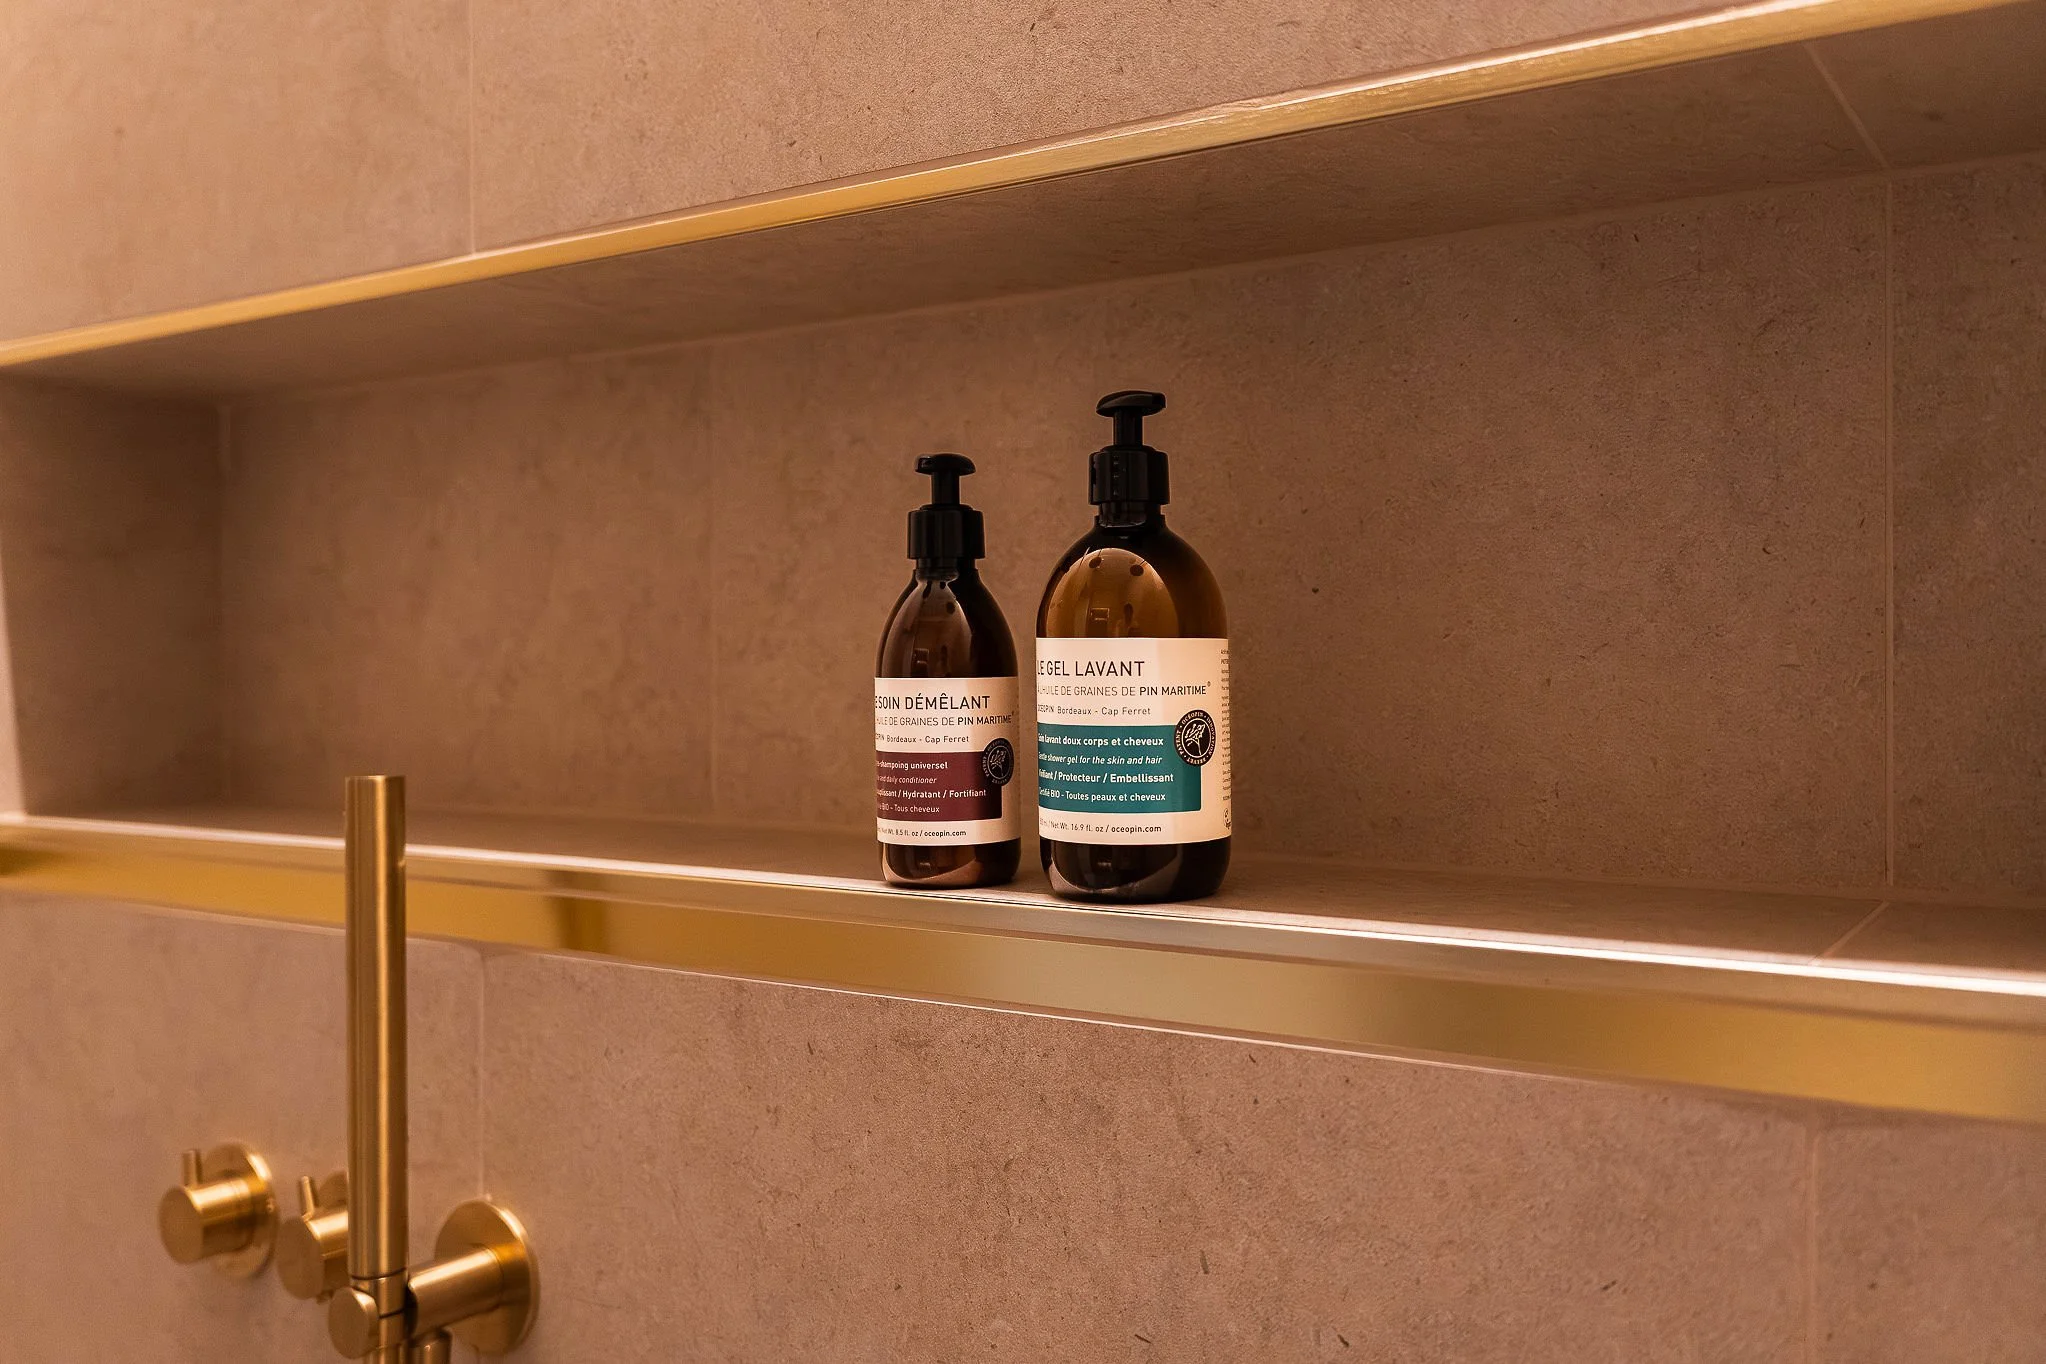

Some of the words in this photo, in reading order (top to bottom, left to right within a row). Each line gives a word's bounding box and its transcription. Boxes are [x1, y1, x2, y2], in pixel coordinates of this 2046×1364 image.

[1046, 660, 1070, 676] GEL
[1075, 660, 1145, 677] LAVANT
[1060, 685, 1072, 696] DE
[1074, 686, 1118, 697] GRAINES
[1121, 686, 1136, 697] DE
[1139, 686, 1158, 696] PIN
[878, 696, 900, 710] SOIN
[905, 692, 991, 710] DÉMÊLANT
[1057, 705, 1092, 715] Bordeaux
[1101, 706, 1119, 717] Cap
[1122, 706, 1151, 715] Ferret
[889, 716, 899, 726] DE
[900, 716, 939, 727] GRAINES
[941, 716, 955, 726] DE
[957, 716, 974, 726] PIN
[886, 734, 917, 743] Bordeaux
[925, 735, 940, 745] Cap
[943, 735, 970, 743] Ferret
[1045, 734, 1062, 745] lavant
[1062, 735, 1082, 746] doux
[1083, 738, 1109, 748] corps
[1111, 737, 1121, 746] et
[1123, 736, 1164, 746] cheveux
[910, 761, 948, 769] universel
[1066, 755, 1078, 766] gel
[1079, 755, 1091, 764] for
[1092, 756, 1105, 765] the
[1106, 755, 1125, 765] skin
[1127, 756, 1144, 765] and
[1145, 755, 1163, 764] hair
[898, 777, 938, 785] conditioner
[1058, 771, 1101, 783] Protecteur
[1102, 772, 1108, 784] /
[1110, 773, 1174, 783] Embellissant
[902, 790, 941, 799] Hydratant
[949, 789, 987, 798] Fortifiant
[1050, 789, 1061, 799] BIO
[1065, 790, 1090, 801] Toutes
[1091, 793, 1117, 803] peaux
[1118, 793, 1128, 801] et
[1129, 792, 1166, 801] cheveux
[894, 804, 909, 813] Tous
[909, 804, 940, 813] cheveux
[924, 830, 967, 838] oceopin.com
[1111, 825, 1162, 834] oceopin.com
